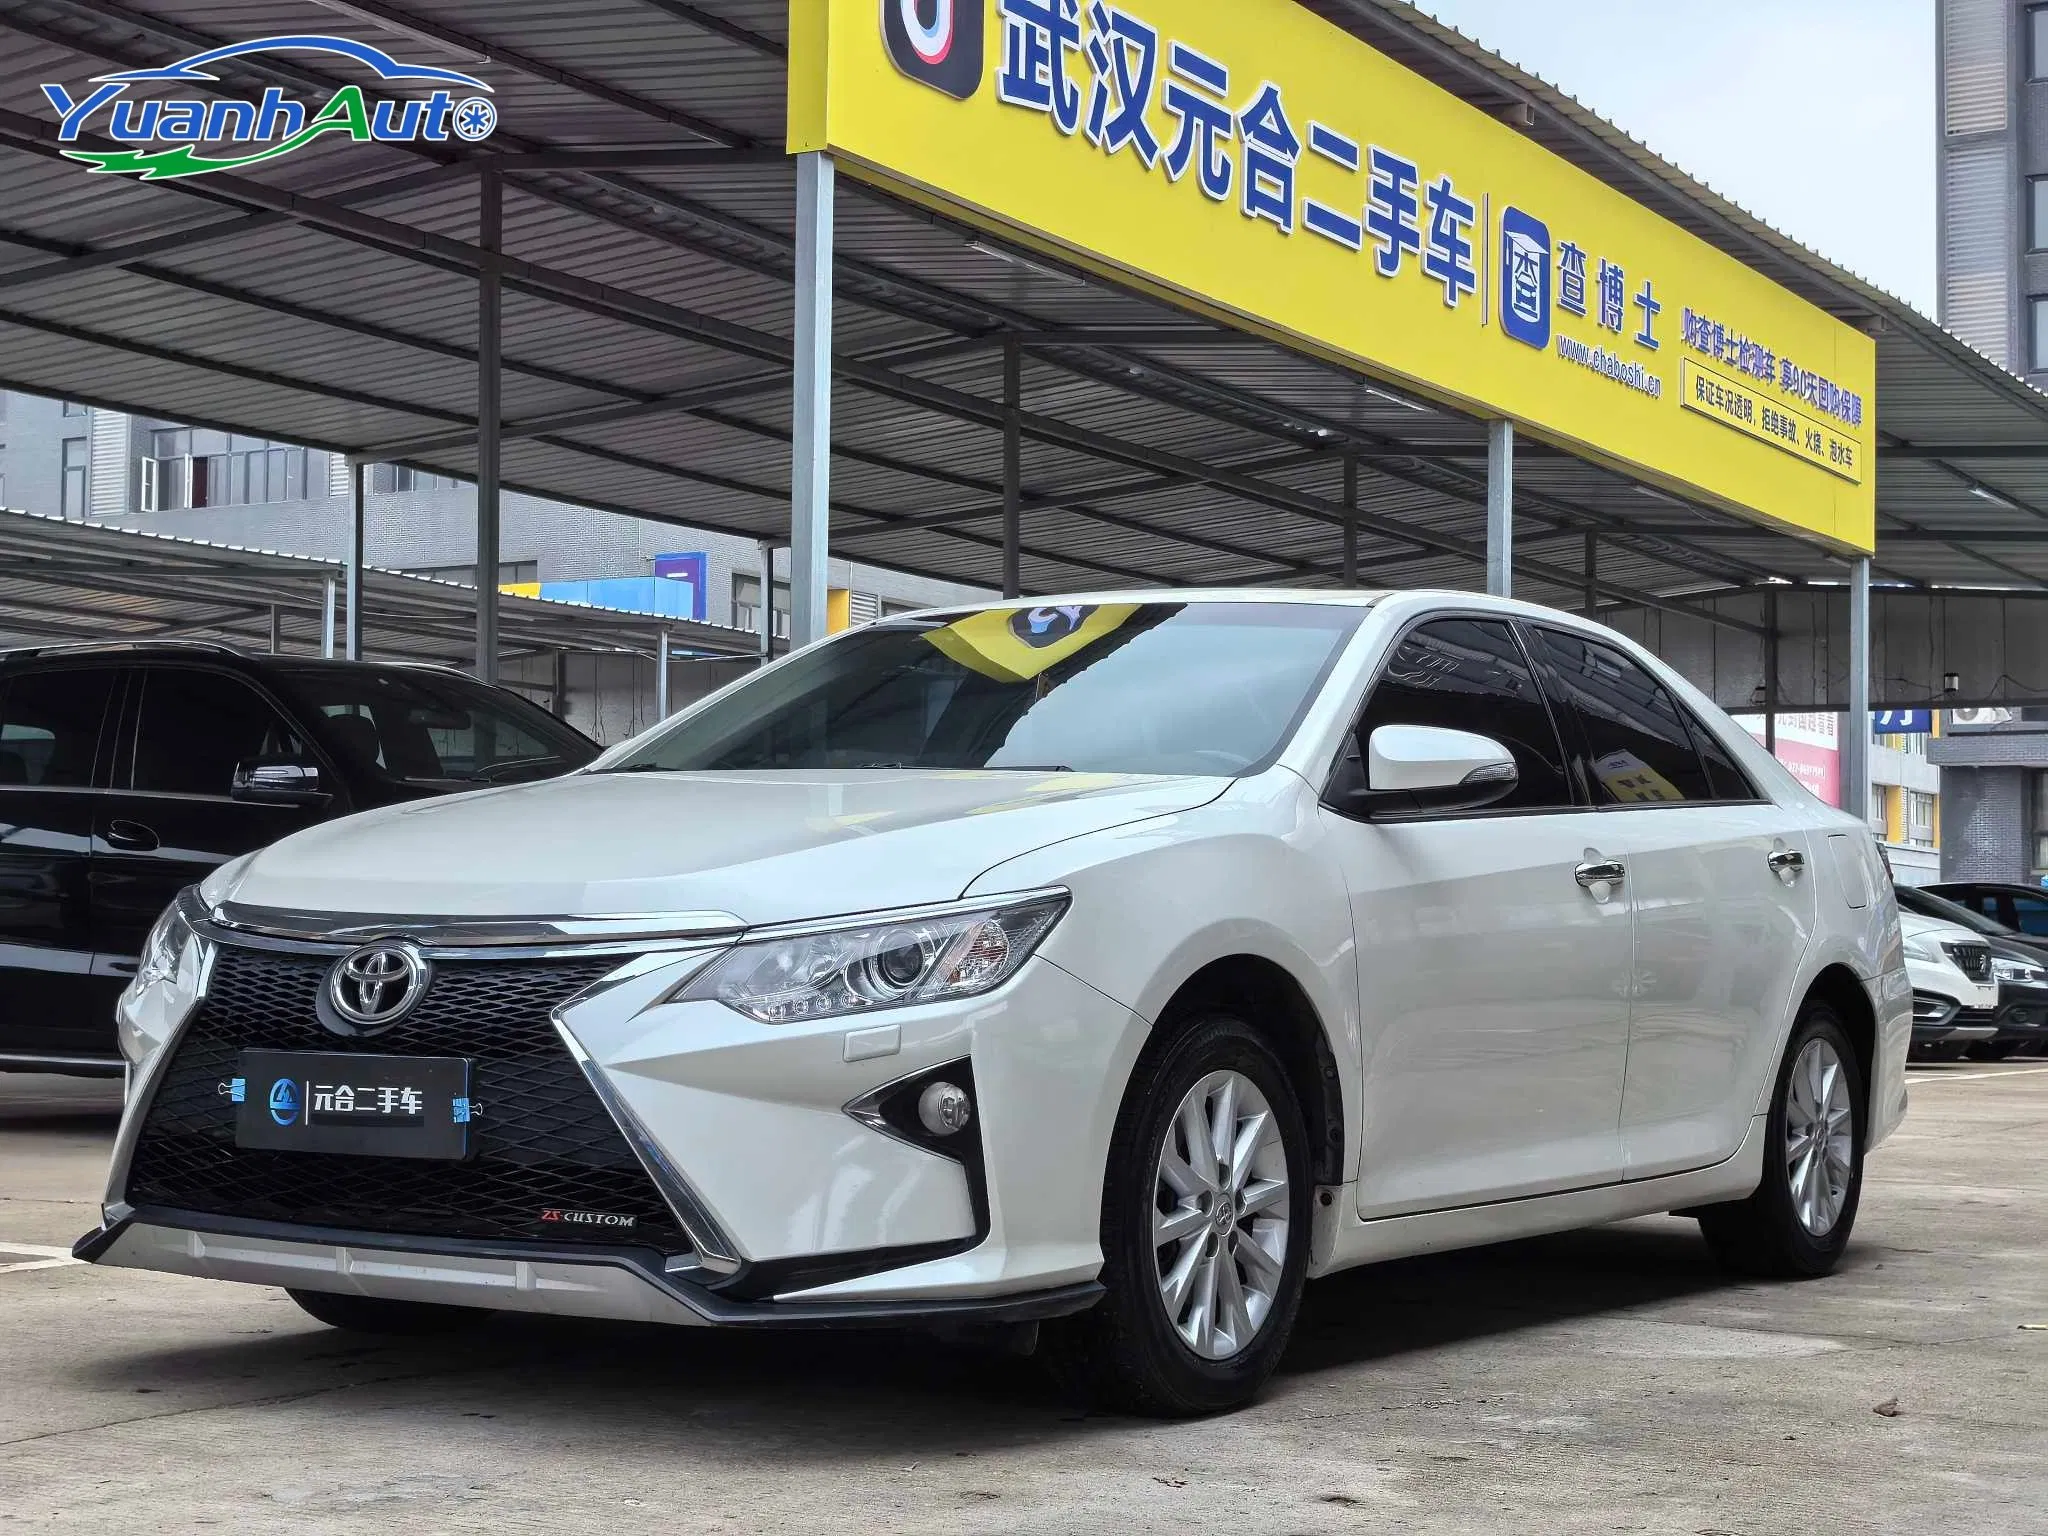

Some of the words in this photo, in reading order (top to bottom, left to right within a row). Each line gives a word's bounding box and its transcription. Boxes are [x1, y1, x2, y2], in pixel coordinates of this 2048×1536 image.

[998, 0, 1477, 308] 武汉元合二手车
[1556, 239, 1661, 350] 查博士
[1556, 334, 1662, 399] www.chaboshi.cn
[1681, 307, 1776, 386] 购查博士检测车
[1779, 357, 1862, 430] 享90天回购保障
[314, 1085, 423, 1115] 元合二手车
[564, 1211, 635, 1227] CUSTOM
